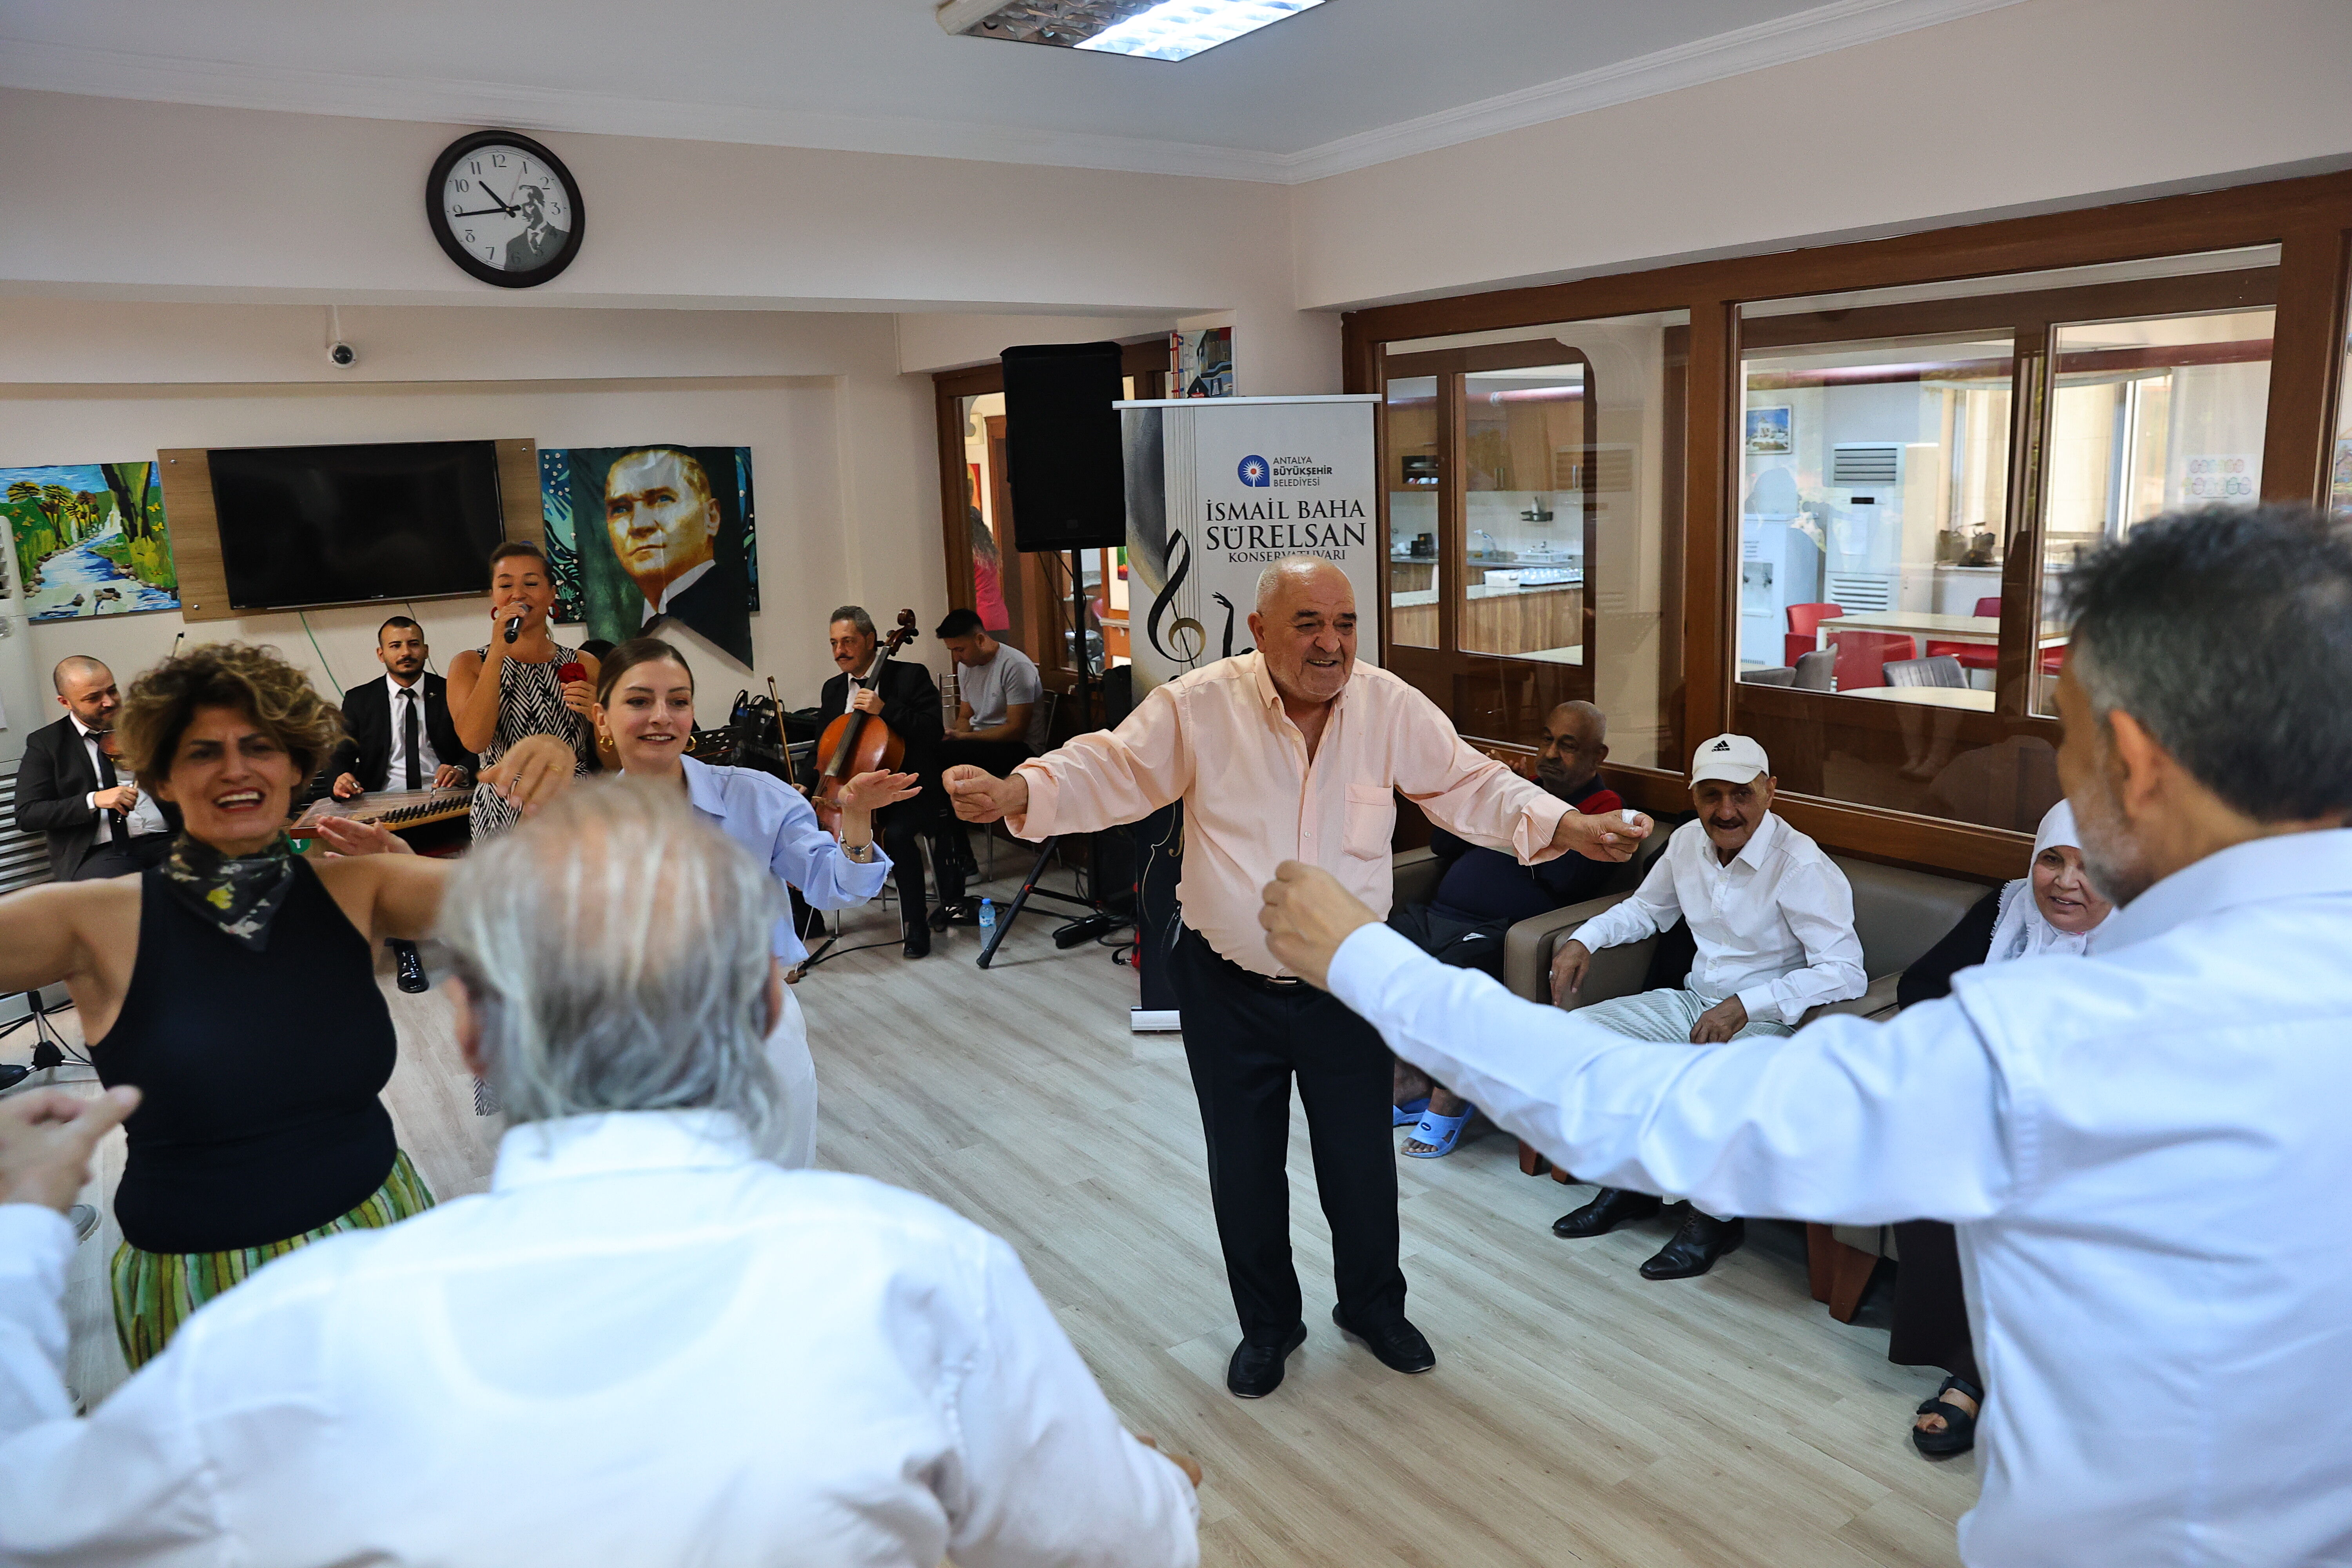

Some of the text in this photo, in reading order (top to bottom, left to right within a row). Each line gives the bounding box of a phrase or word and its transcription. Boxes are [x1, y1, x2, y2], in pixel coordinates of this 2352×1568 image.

[492, 154, 507, 168] 12
[523, 161, 528, 174] 1
[471, 161, 481, 175] 11
[455, 179, 469, 192] 10
[539, 176, 550, 190] 2
[453, 204, 463, 218] 9
[550, 202, 561, 215] 3
[465, 229, 475, 243] 8
[485, 247, 495, 260] 7
[1272, 456, 1313, 465] ANTALYA
[1273, 465, 1333, 477] BÜYÜKŞEHİR
[1274, 477, 1320, 487] BELEDİYESİ
[1206, 497, 1367, 521] İSMAİL BAHA
[1206, 522, 1367, 550] SÜRELSAN
